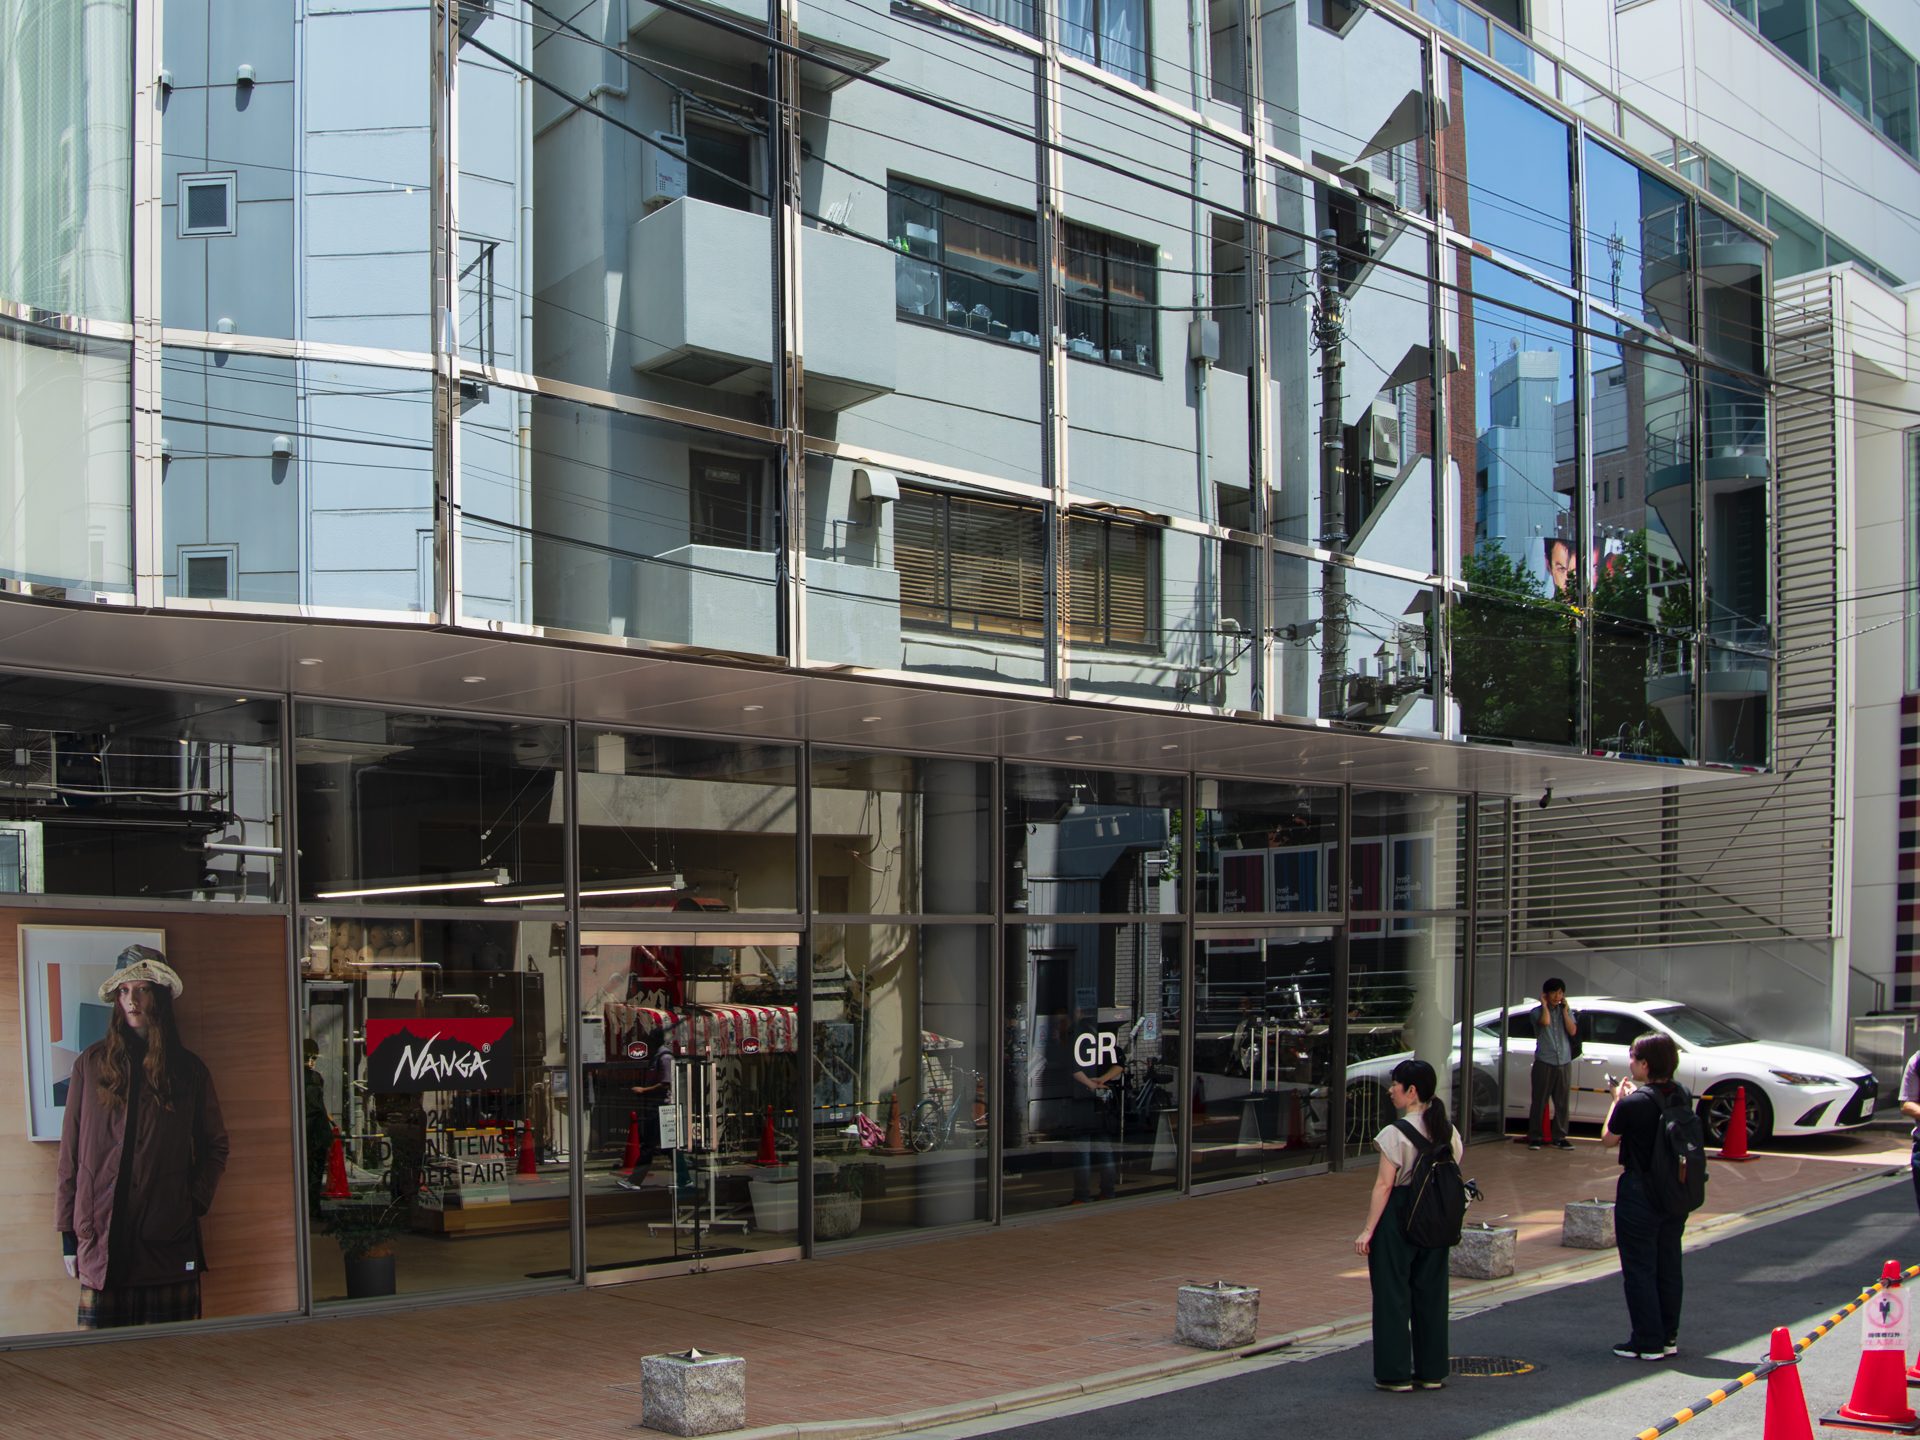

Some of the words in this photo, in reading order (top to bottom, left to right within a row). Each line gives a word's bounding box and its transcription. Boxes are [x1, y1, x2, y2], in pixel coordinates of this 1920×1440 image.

[392, 1031, 490, 1087] NANGA
[1073, 1031, 1118, 1067] GR
[460, 1162, 506, 1184] FAIR
